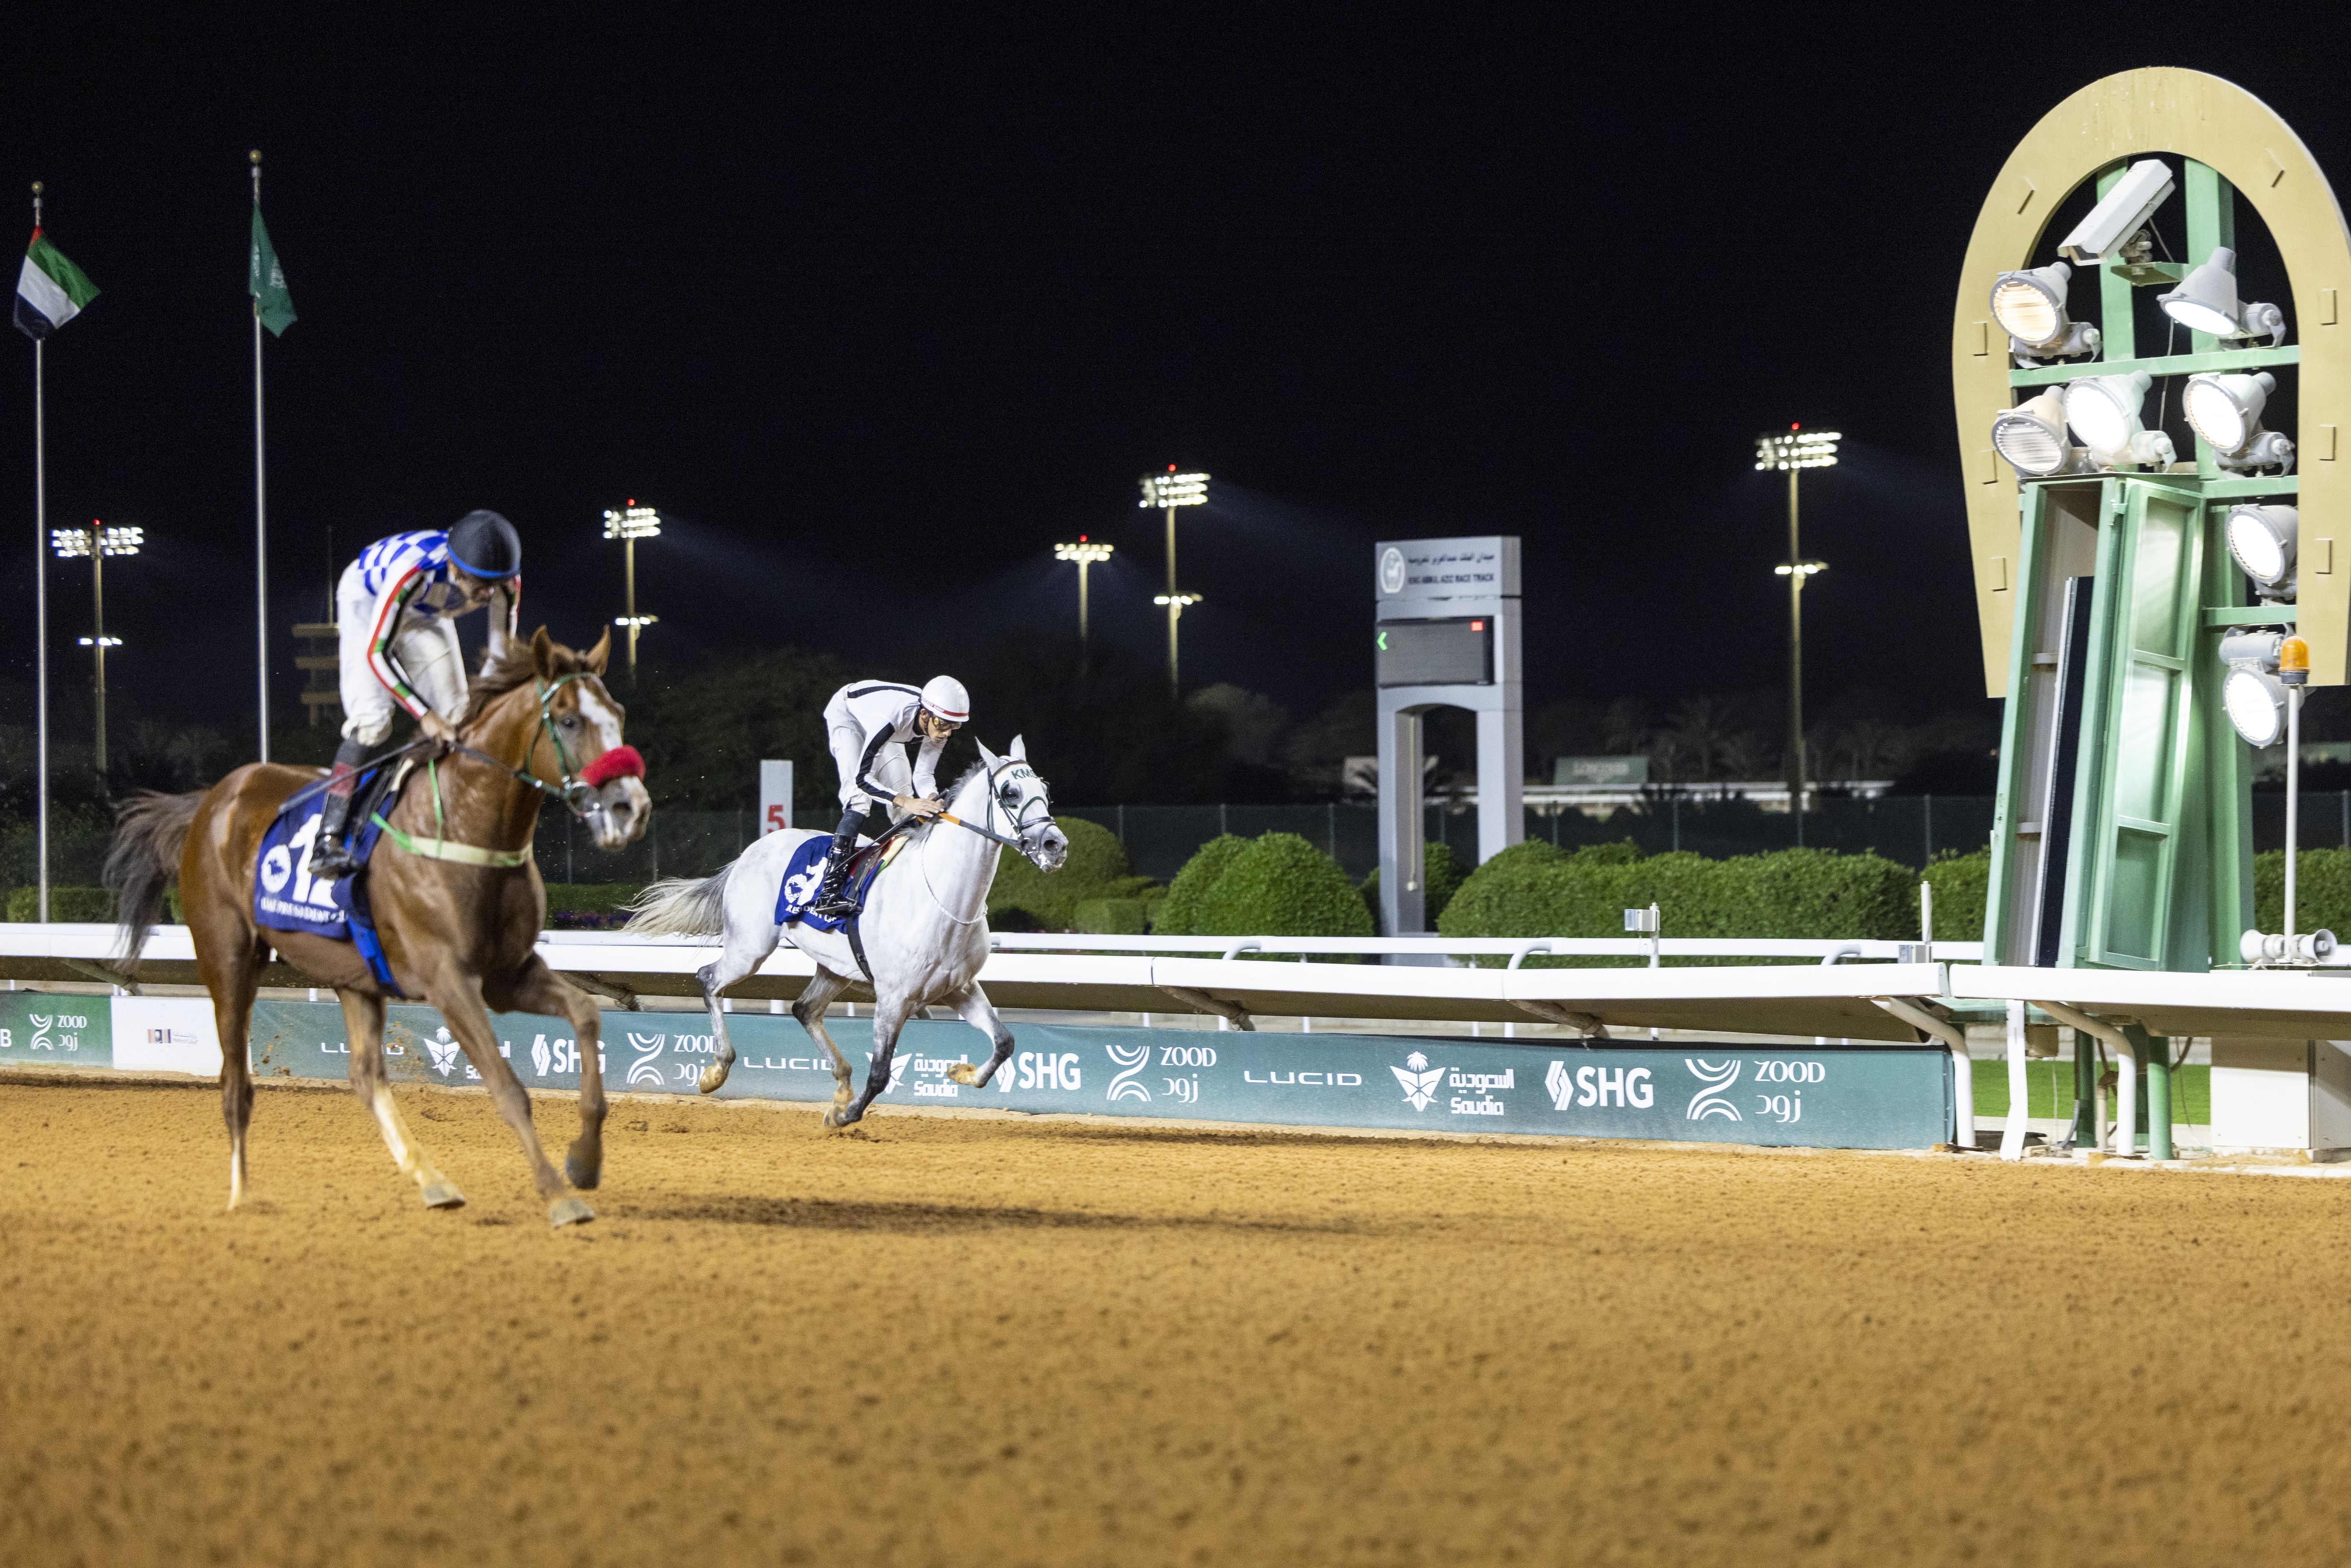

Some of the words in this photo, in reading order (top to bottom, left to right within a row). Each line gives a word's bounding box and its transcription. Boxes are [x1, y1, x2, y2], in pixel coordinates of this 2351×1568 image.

[1011, 769, 1038, 780] KMS
[767, 804, 786, 834] 5
[57, 1015, 87, 1028] ZOOD
[58, 1032, 78, 1051] زود
[321, 1042, 404, 1055] LUD
[1160, 1046, 1217, 1067] ZOOD
[1018, 1052, 1081, 1091] SHG
[1244, 1071, 1362, 1086] LUCID
[1449, 1067, 1514, 1094] السعودية
[1754, 1060, 1825, 1083] ZOOD
[913, 1078, 958, 1097] Saudia
[1162, 1073, 1198, 1103] زود
[1576, 1066, 1654, 1109] SHG
[1450, 1095, 1504, 1116] Saudia
[1755, 1090, 1801, 1123] زود
